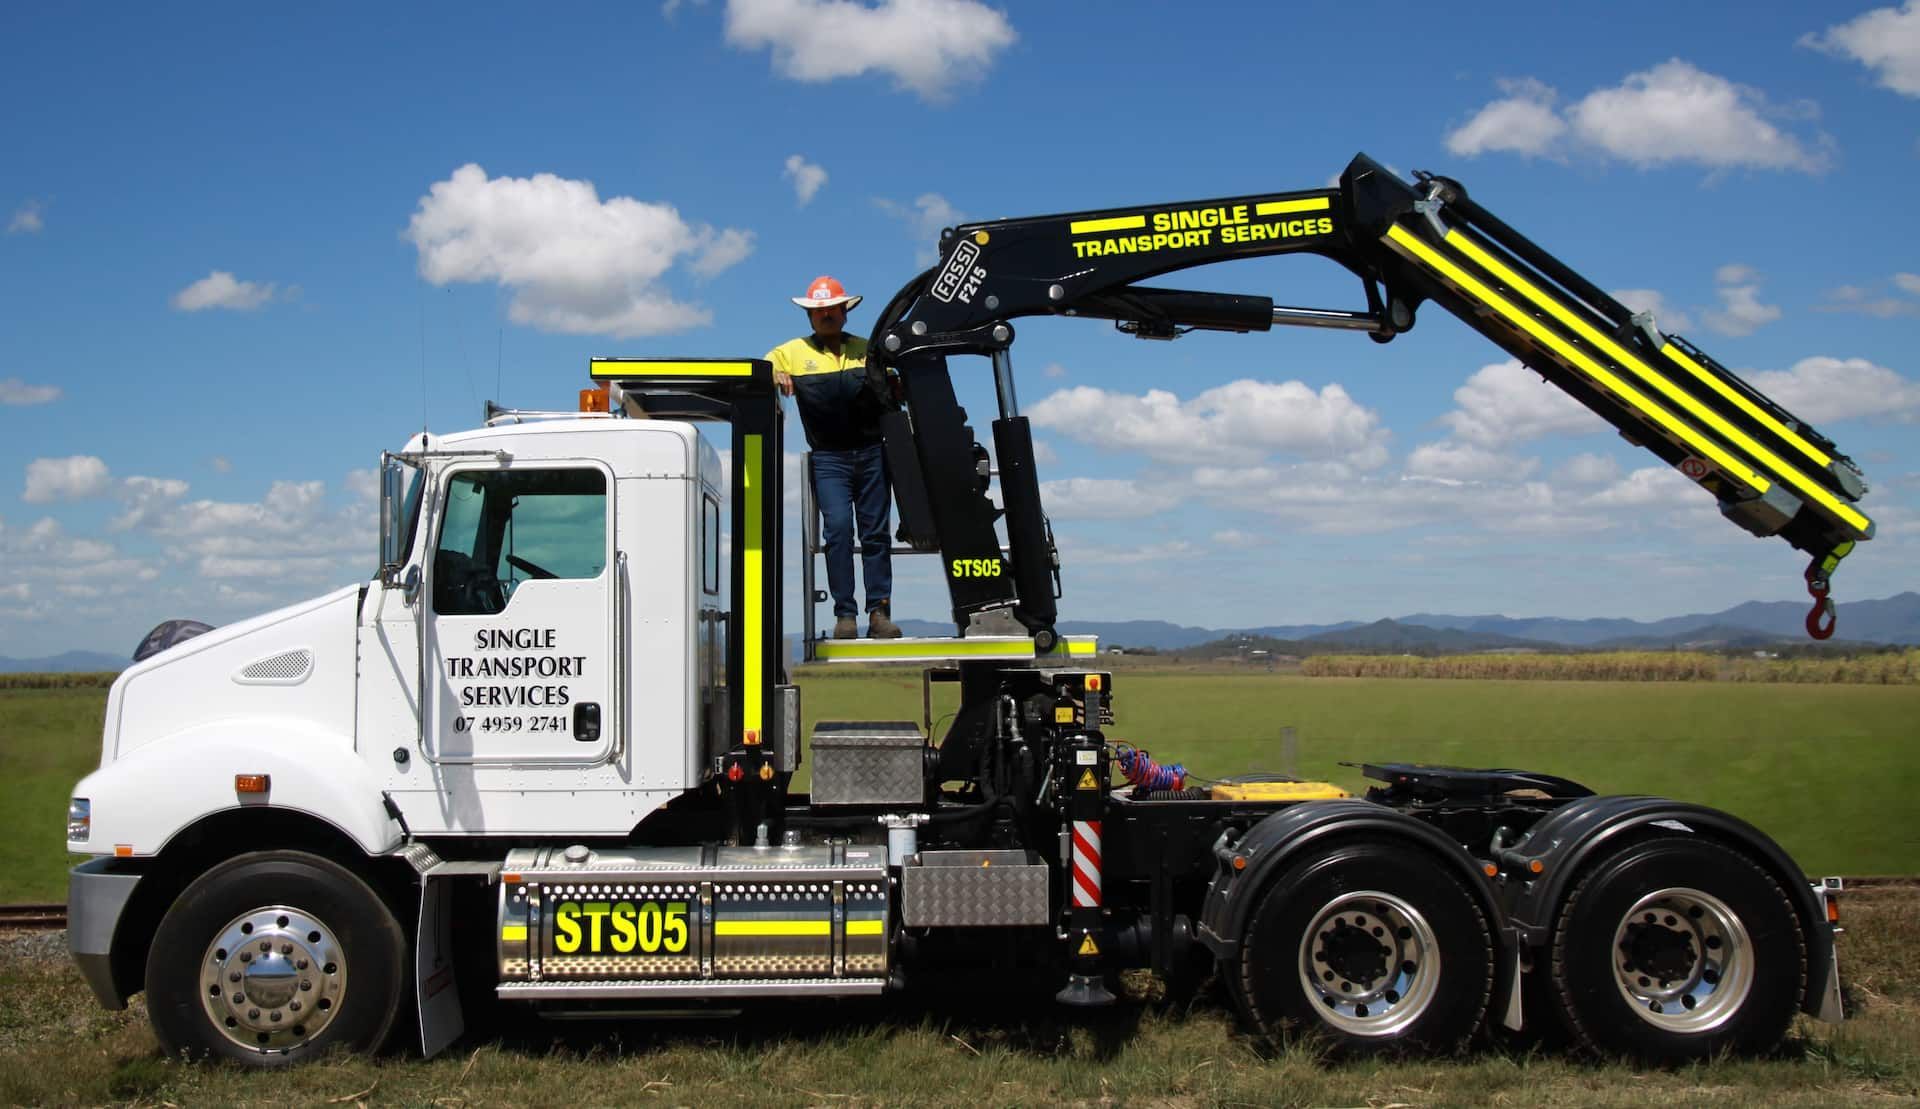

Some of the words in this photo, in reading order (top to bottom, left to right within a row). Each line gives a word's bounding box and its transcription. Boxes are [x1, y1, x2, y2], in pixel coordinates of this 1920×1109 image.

[1153, 205, 1249, 232] SINGLE
[1072, 229, 1212, 258] TRANSPORT
[1221, 218, 1333, 244] SERVICES
[936, 245, 975, 297] FASSI
[957, 266, 987, 304] F215
[952, 558, 1001, 578] STS05
[476, 628, 556, 650] SINGLE
[447, 656, 587, 678] TRANSPORT
[462, 685, 570, 707] SERVICES
[455, 716, 475, 732] 07
[481, 716, 523, 732] 4959
[529, 716, 568, 732] 2741
[554, 901, 688, 953] STS05
